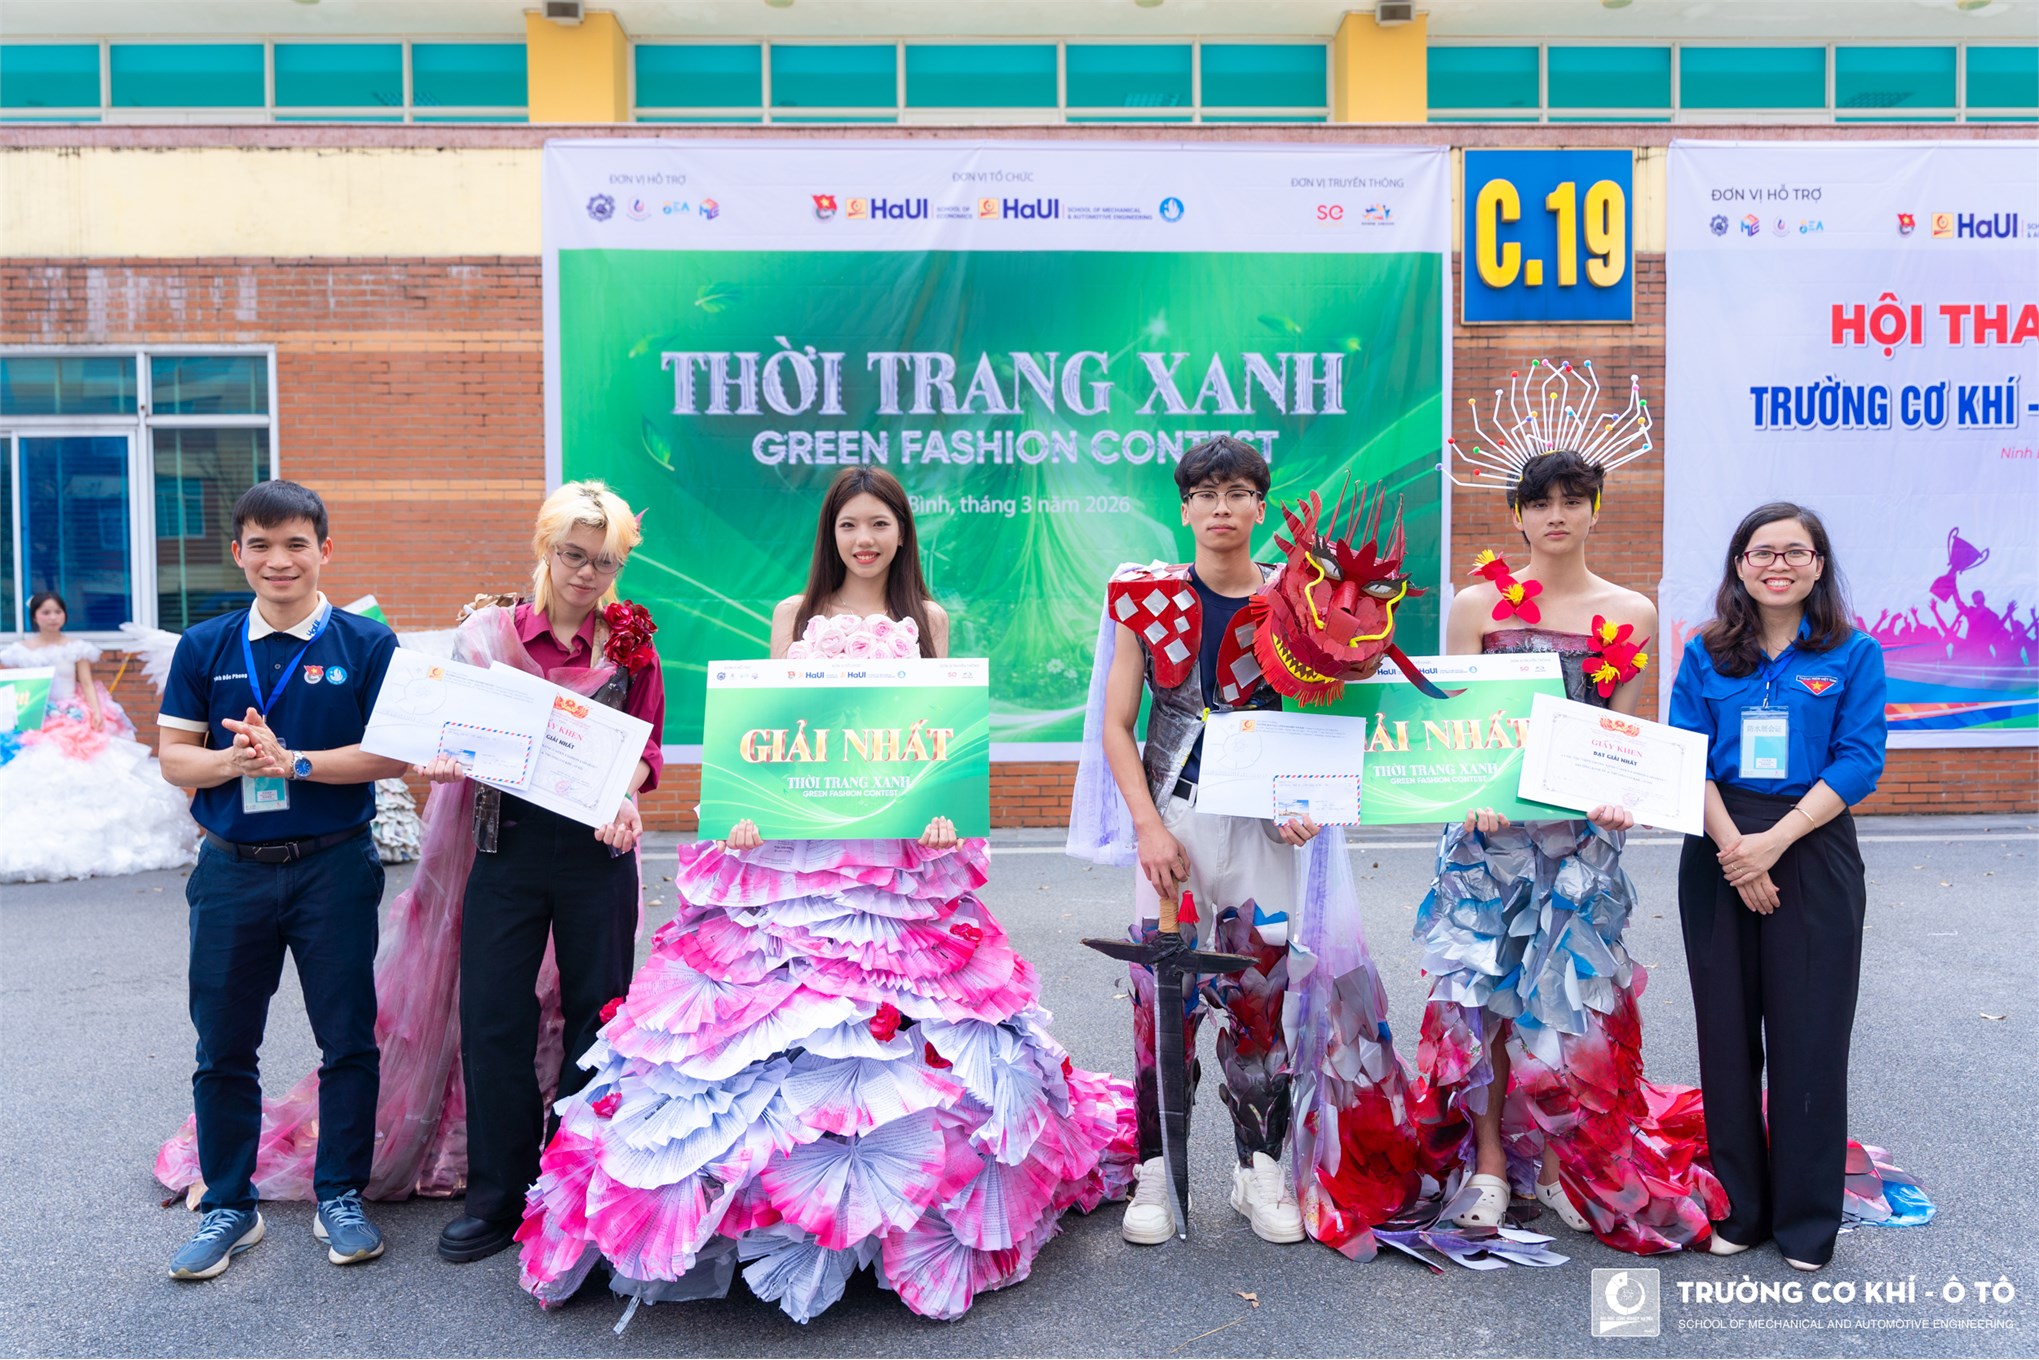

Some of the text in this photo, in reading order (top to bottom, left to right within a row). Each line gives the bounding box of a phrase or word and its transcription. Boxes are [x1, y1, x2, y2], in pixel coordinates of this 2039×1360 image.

[1711, 184, 1822, 203] ĐƠN VỊ HỖ TRỢ
[1476, 178, 1626, 288] C.19
[1831, 292, 2039, 357] HỘI THA
[661, 335, 1348, 416] THỜI TRANG XANH
[1750, 374, 1888, 426] TRƯỜNG
[1901, 381, 1946, 426] CƠ
[1958, 376, 2018, 426] KHÍ
[752, 430, 889, 465] GREEN
[901, 430, 1078, 464] FASHION
[2000, 446, 2033, 459] Ninh
[960, 495, 1018, 518] tháng
[1021, 496, 1032, 513] 3
[1038, 495, 1081, 513] năm
[1086, 496, 1131, 514] 2026
[739, 718, 955, 764] GIẢI NHẤT
[1422, 709, 1531, 751] NHẤT
[787, 774, 911, 789] THỜI TRANG XANH
[1409, 763, 1456, 776] TRANG
